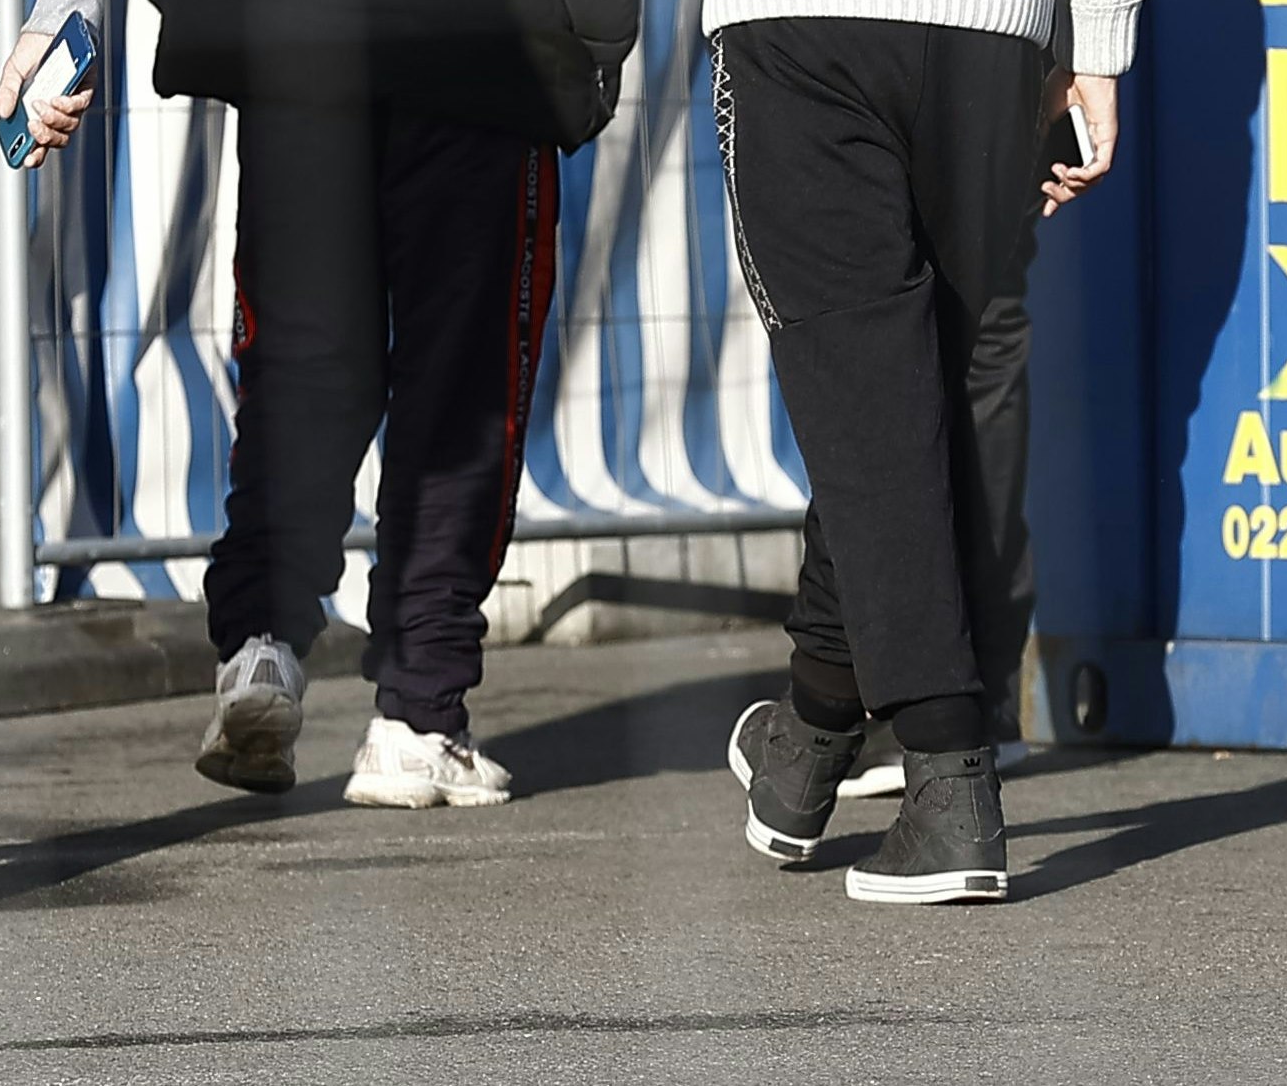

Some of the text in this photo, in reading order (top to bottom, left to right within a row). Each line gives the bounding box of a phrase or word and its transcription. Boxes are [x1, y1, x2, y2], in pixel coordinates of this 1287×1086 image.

[525, 145, 540, 221] ACOSTE
[517, 236, 535, 324] LACOSTE
[514, 340, 531, 426] LACOSTE
